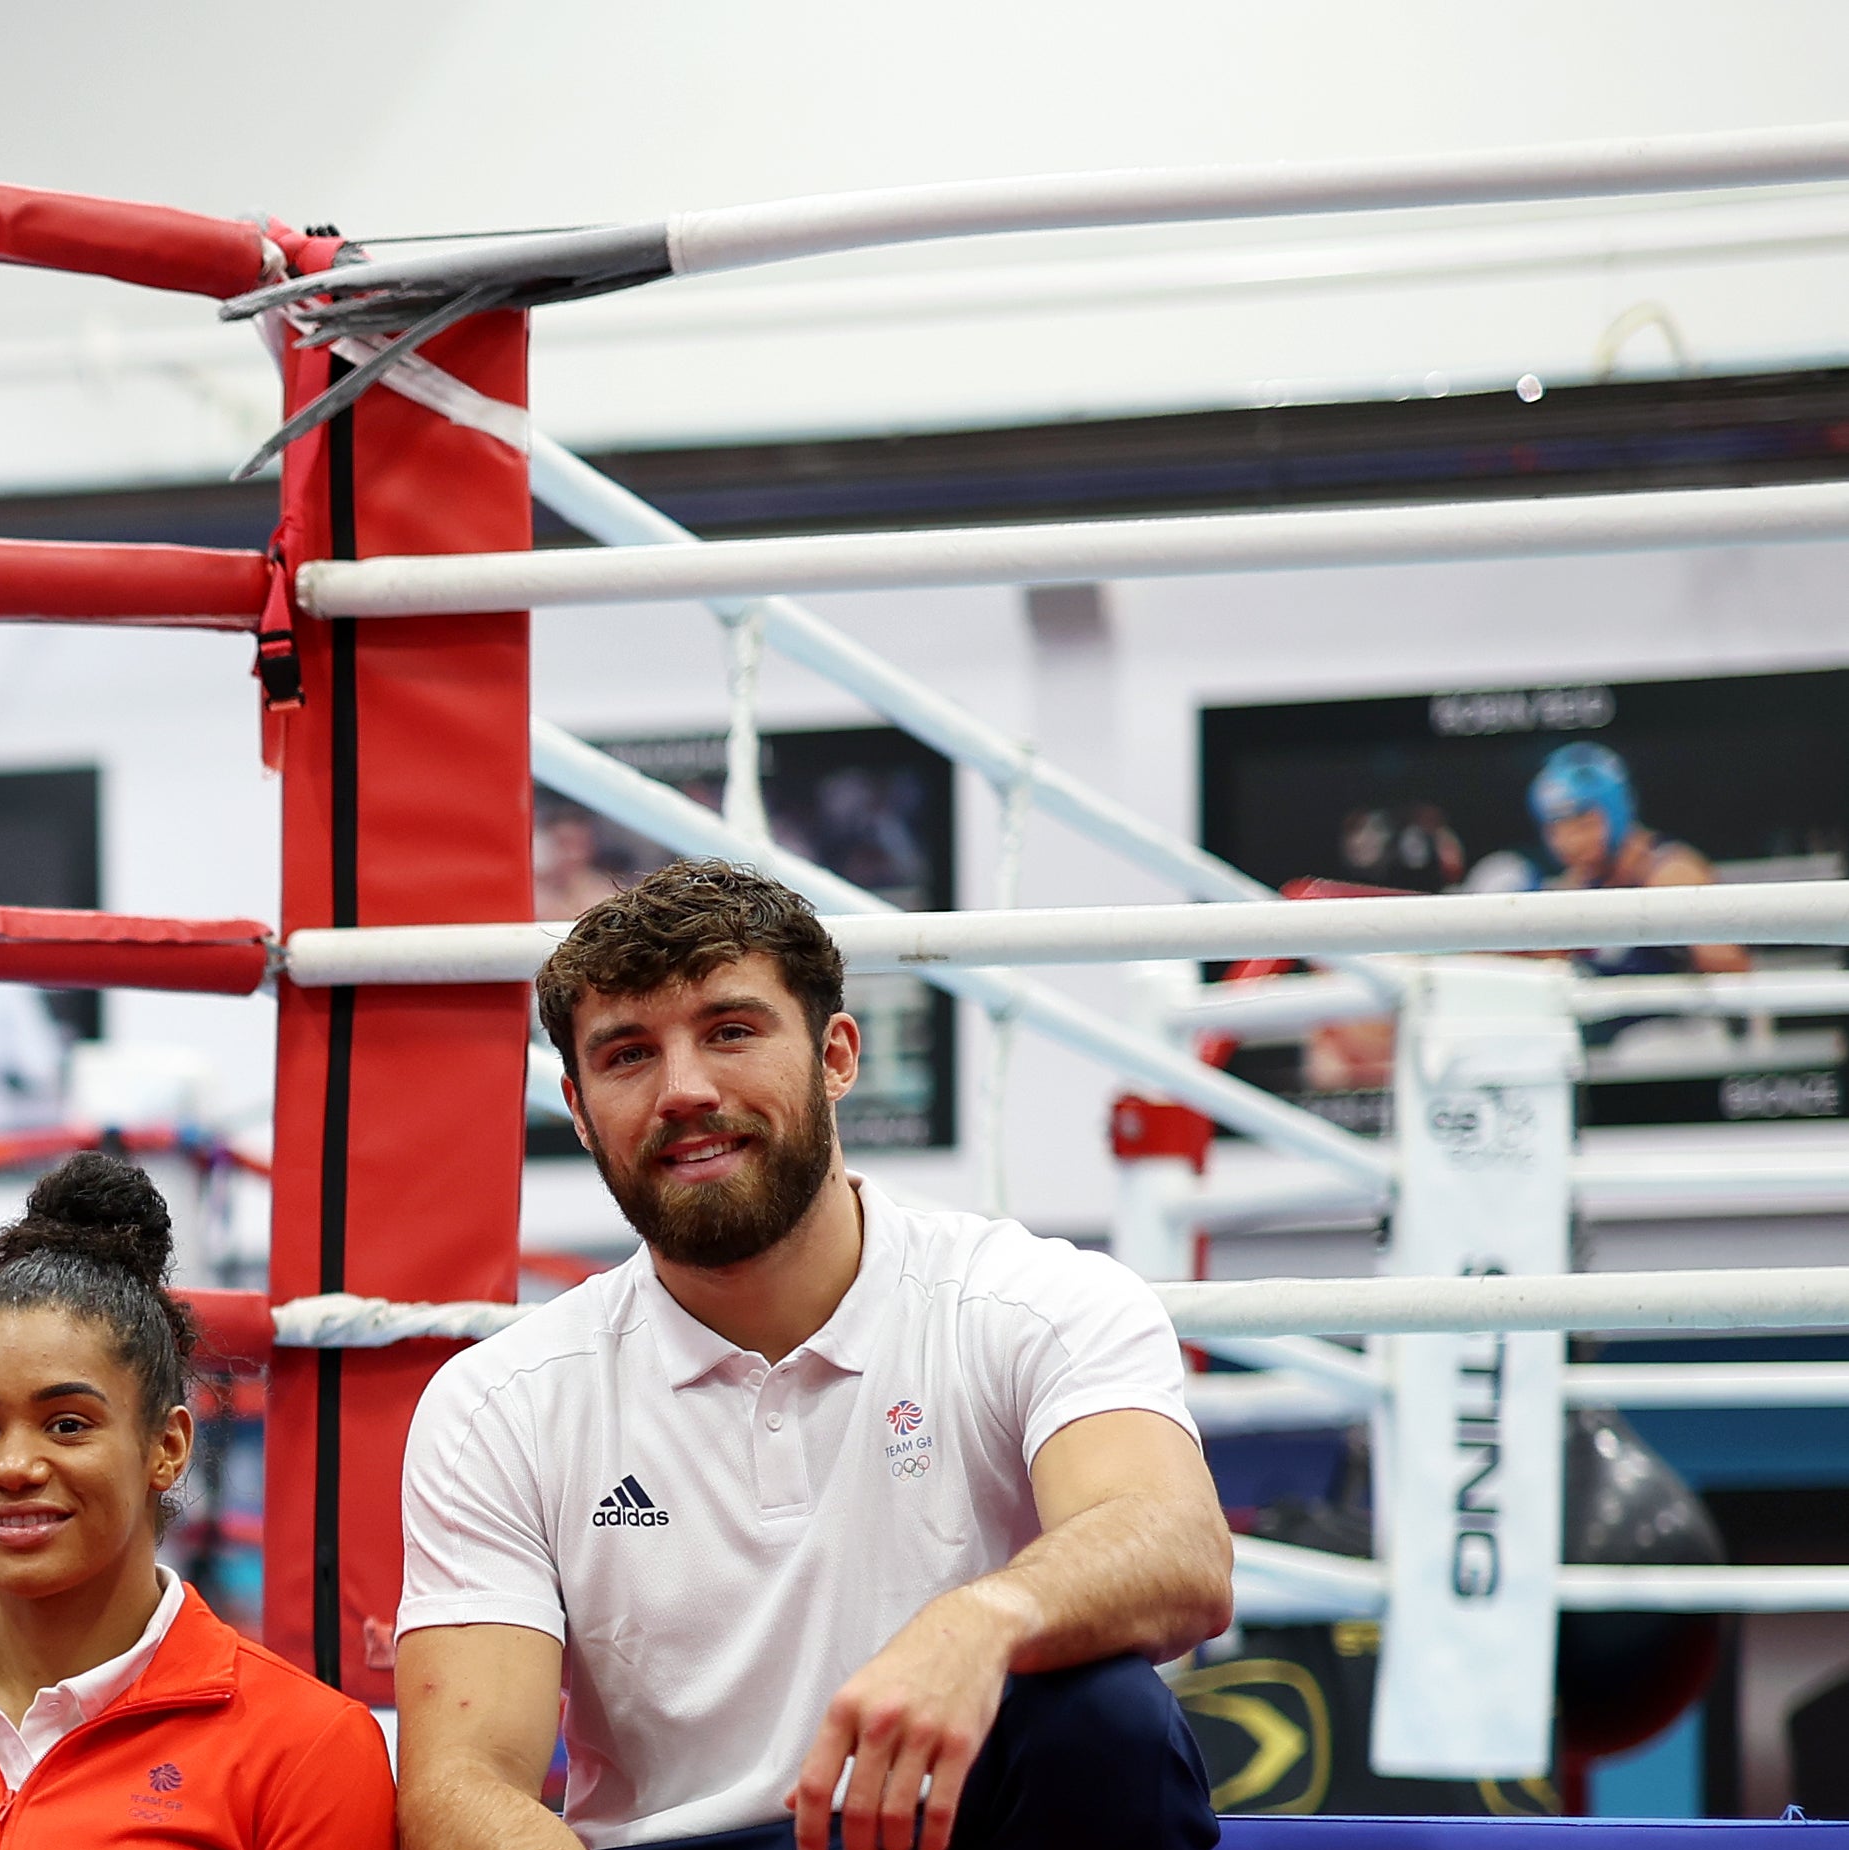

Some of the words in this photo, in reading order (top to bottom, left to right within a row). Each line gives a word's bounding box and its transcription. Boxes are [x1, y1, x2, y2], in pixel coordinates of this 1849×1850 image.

[1455, 1260, 1506, 1598] TING
[885, 1440, 913, 1458] TEAM
[917, 1436, 933, 1449] GB
[592, 1506, 670, 1527] adidas
